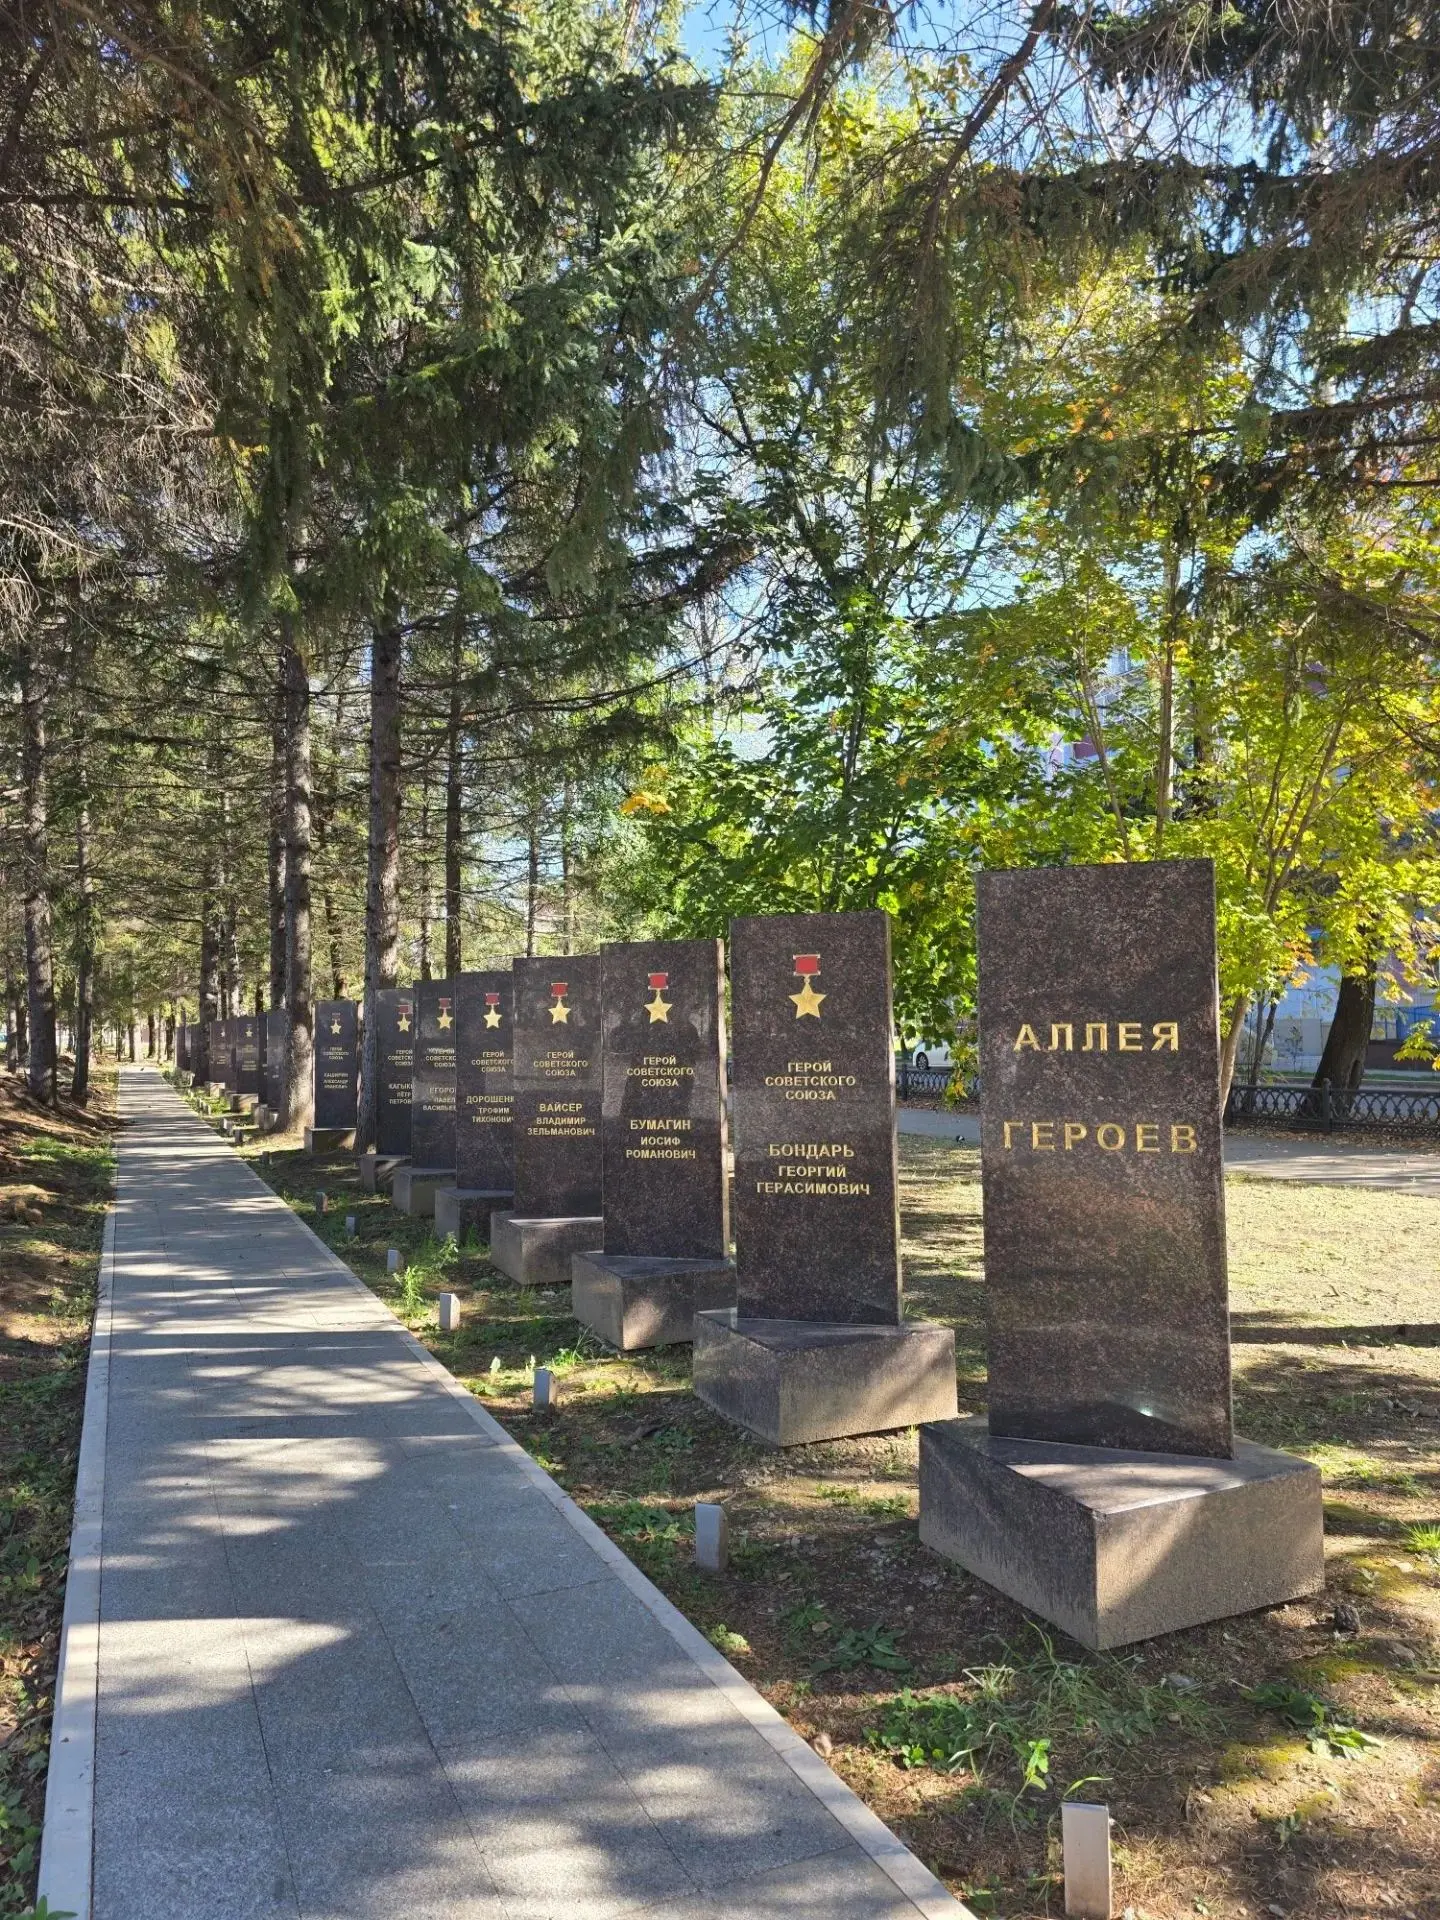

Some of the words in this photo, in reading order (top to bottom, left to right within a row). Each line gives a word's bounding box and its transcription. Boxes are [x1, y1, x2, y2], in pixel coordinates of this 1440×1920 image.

[1013, 1021, 1179, 1052] АЛЛЕЯ
[482, 1050, 505, 1058] ГЕРОЙ
[547, 1051, 574, 1059] ГЕРОЙ
[533, 1060, 589, 1068] СОВЕТСКОГО
[643, 1055, 677, 1066] ГЕРОЙ
[626, 1067, 694, 1076] СОВЕТСКОГО
[787, 1060, 832, 1073] ГЕРОЙ
[545, 1069, 576, 1077] СОЮЗА
[641, 1078, 679, 1087] СОЮЗА
[765, 1075, 856, 1087] СОВЕТСКОГО
[466, 1095, 514, 1105] ДОРОШЕН
[785, 1090, 836, 1100] СОЮЗА
[539, 1101, 583, 1112] ВАЙСЕР
[472, 1115, 514, 1123] ТИХОНОВИ
[536, 1117, 586, 1126] ВЛАДИМИР
[630, 1119, 691, 1130] БУМАГИН
[527, 1127, 596, 1136] ЗЕЛЬМАНОВИЧ
[640, 1136, 681, 1146] ИОСИФ
[1003, 1121, 1197, 1153] ГЕРОЕВ
[626, 1149, 696, 1159] РОМАНОВИЧ
[769, 1143, 855, 1160] БОНДАРЬ
[778, 1164, 846, 1178] ГЕОРГИЙ
[756, 1182, 870, 1195] ГЕРАСИМОВИЧ
